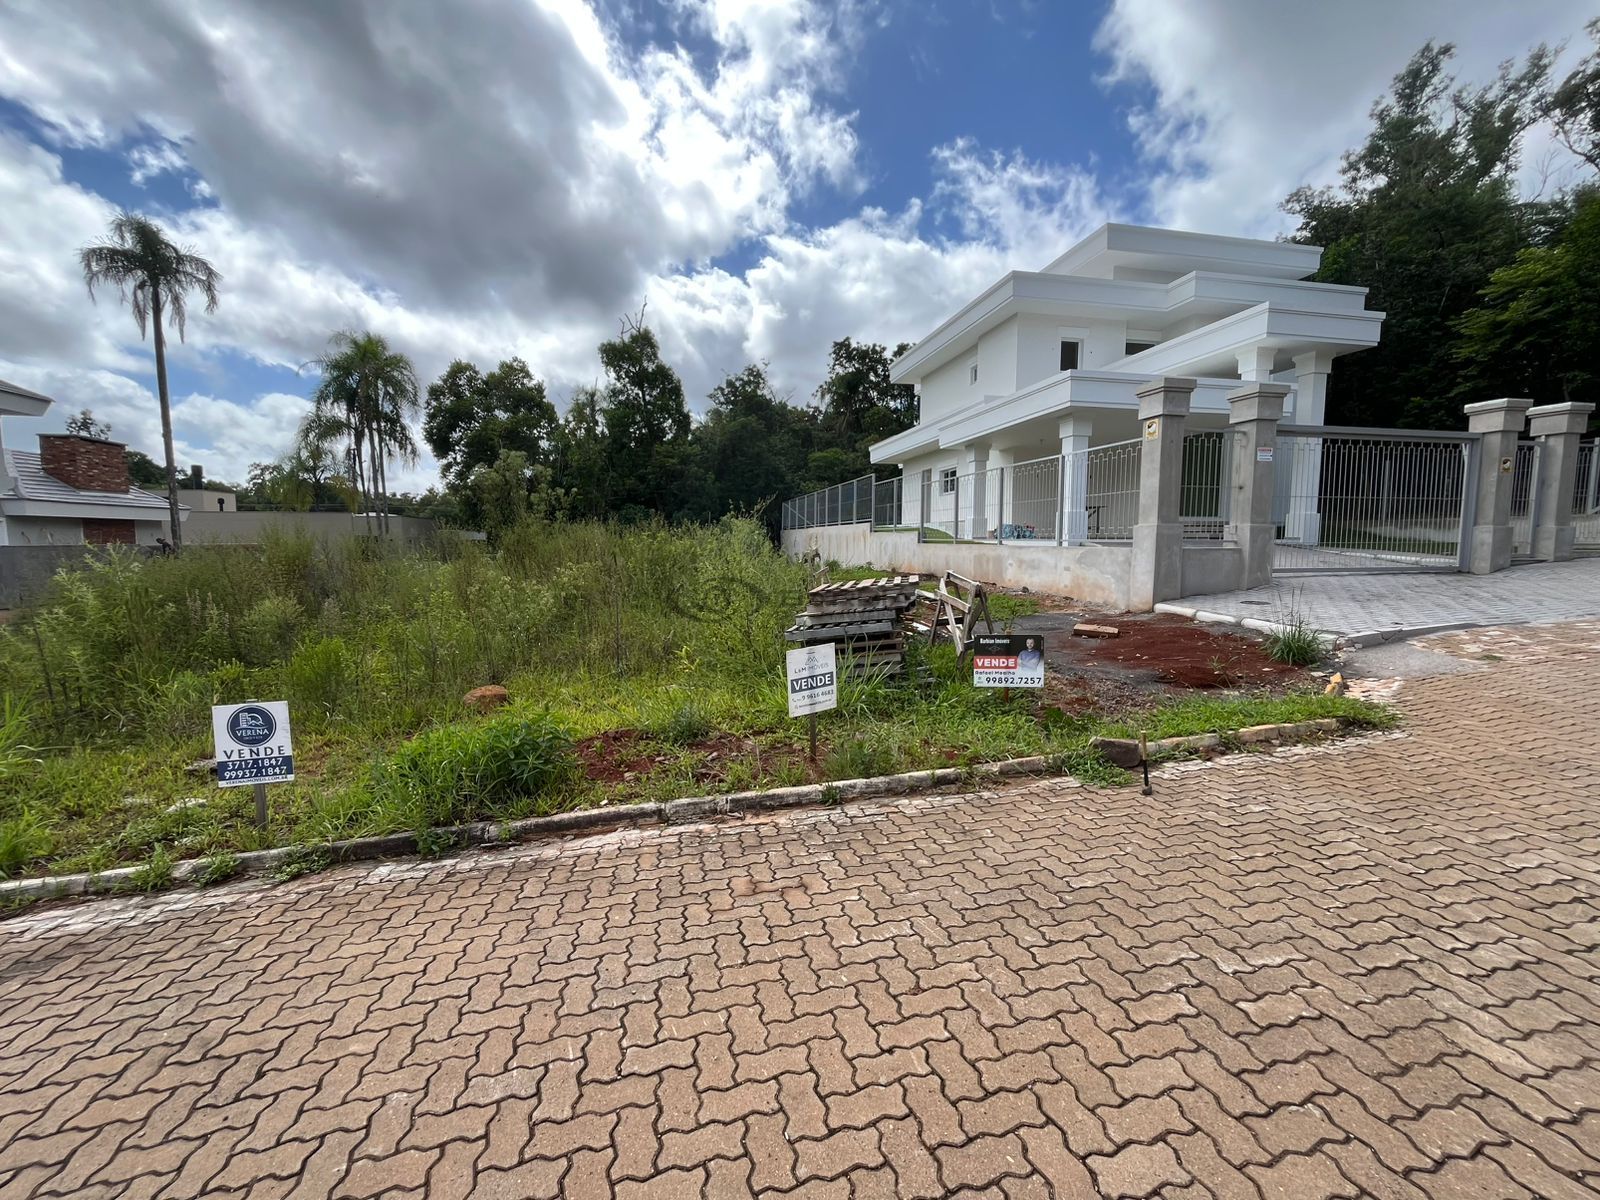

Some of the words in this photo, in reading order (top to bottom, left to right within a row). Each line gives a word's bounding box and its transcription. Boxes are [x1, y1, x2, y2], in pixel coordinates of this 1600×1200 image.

[976, 658, 1016, 667] VENDE
[793, 674, 832, 691] VENDE
[985, 677, 1042, 685] 99892.7257
[235, 728, 270, 737] VERENA
[223, 745, 286, 759] VENDE
[227, 758, 283, 770] 3717.1847
[224, 766, 287, 780] 99937.1847
